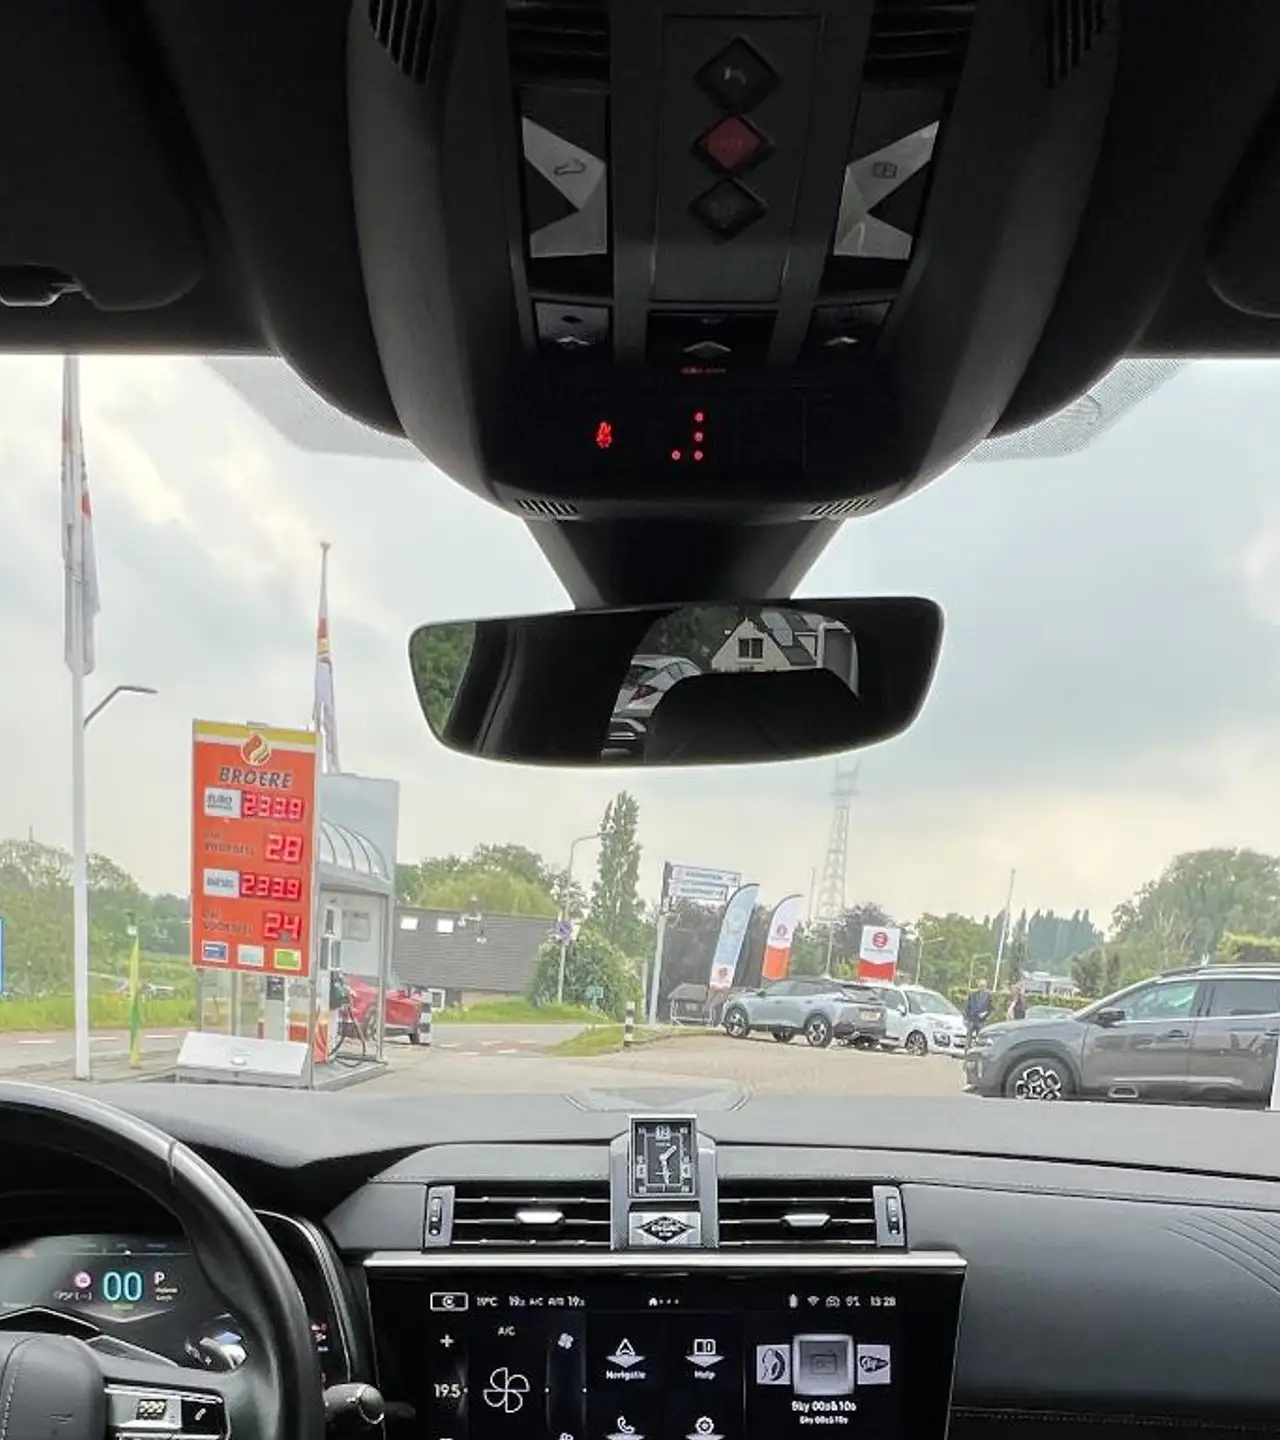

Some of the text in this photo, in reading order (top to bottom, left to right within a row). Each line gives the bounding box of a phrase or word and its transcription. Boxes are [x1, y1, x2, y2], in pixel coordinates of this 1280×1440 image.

[219, 766, 292, 789] BROERE
[265, 833, 302, 861] 28
[263, 911, 300, 940] 24
[103, 1271, 142, 1302] 00
[154, 1271, 165, 1285] P
[497, 1325, 516, 1337] A/C
